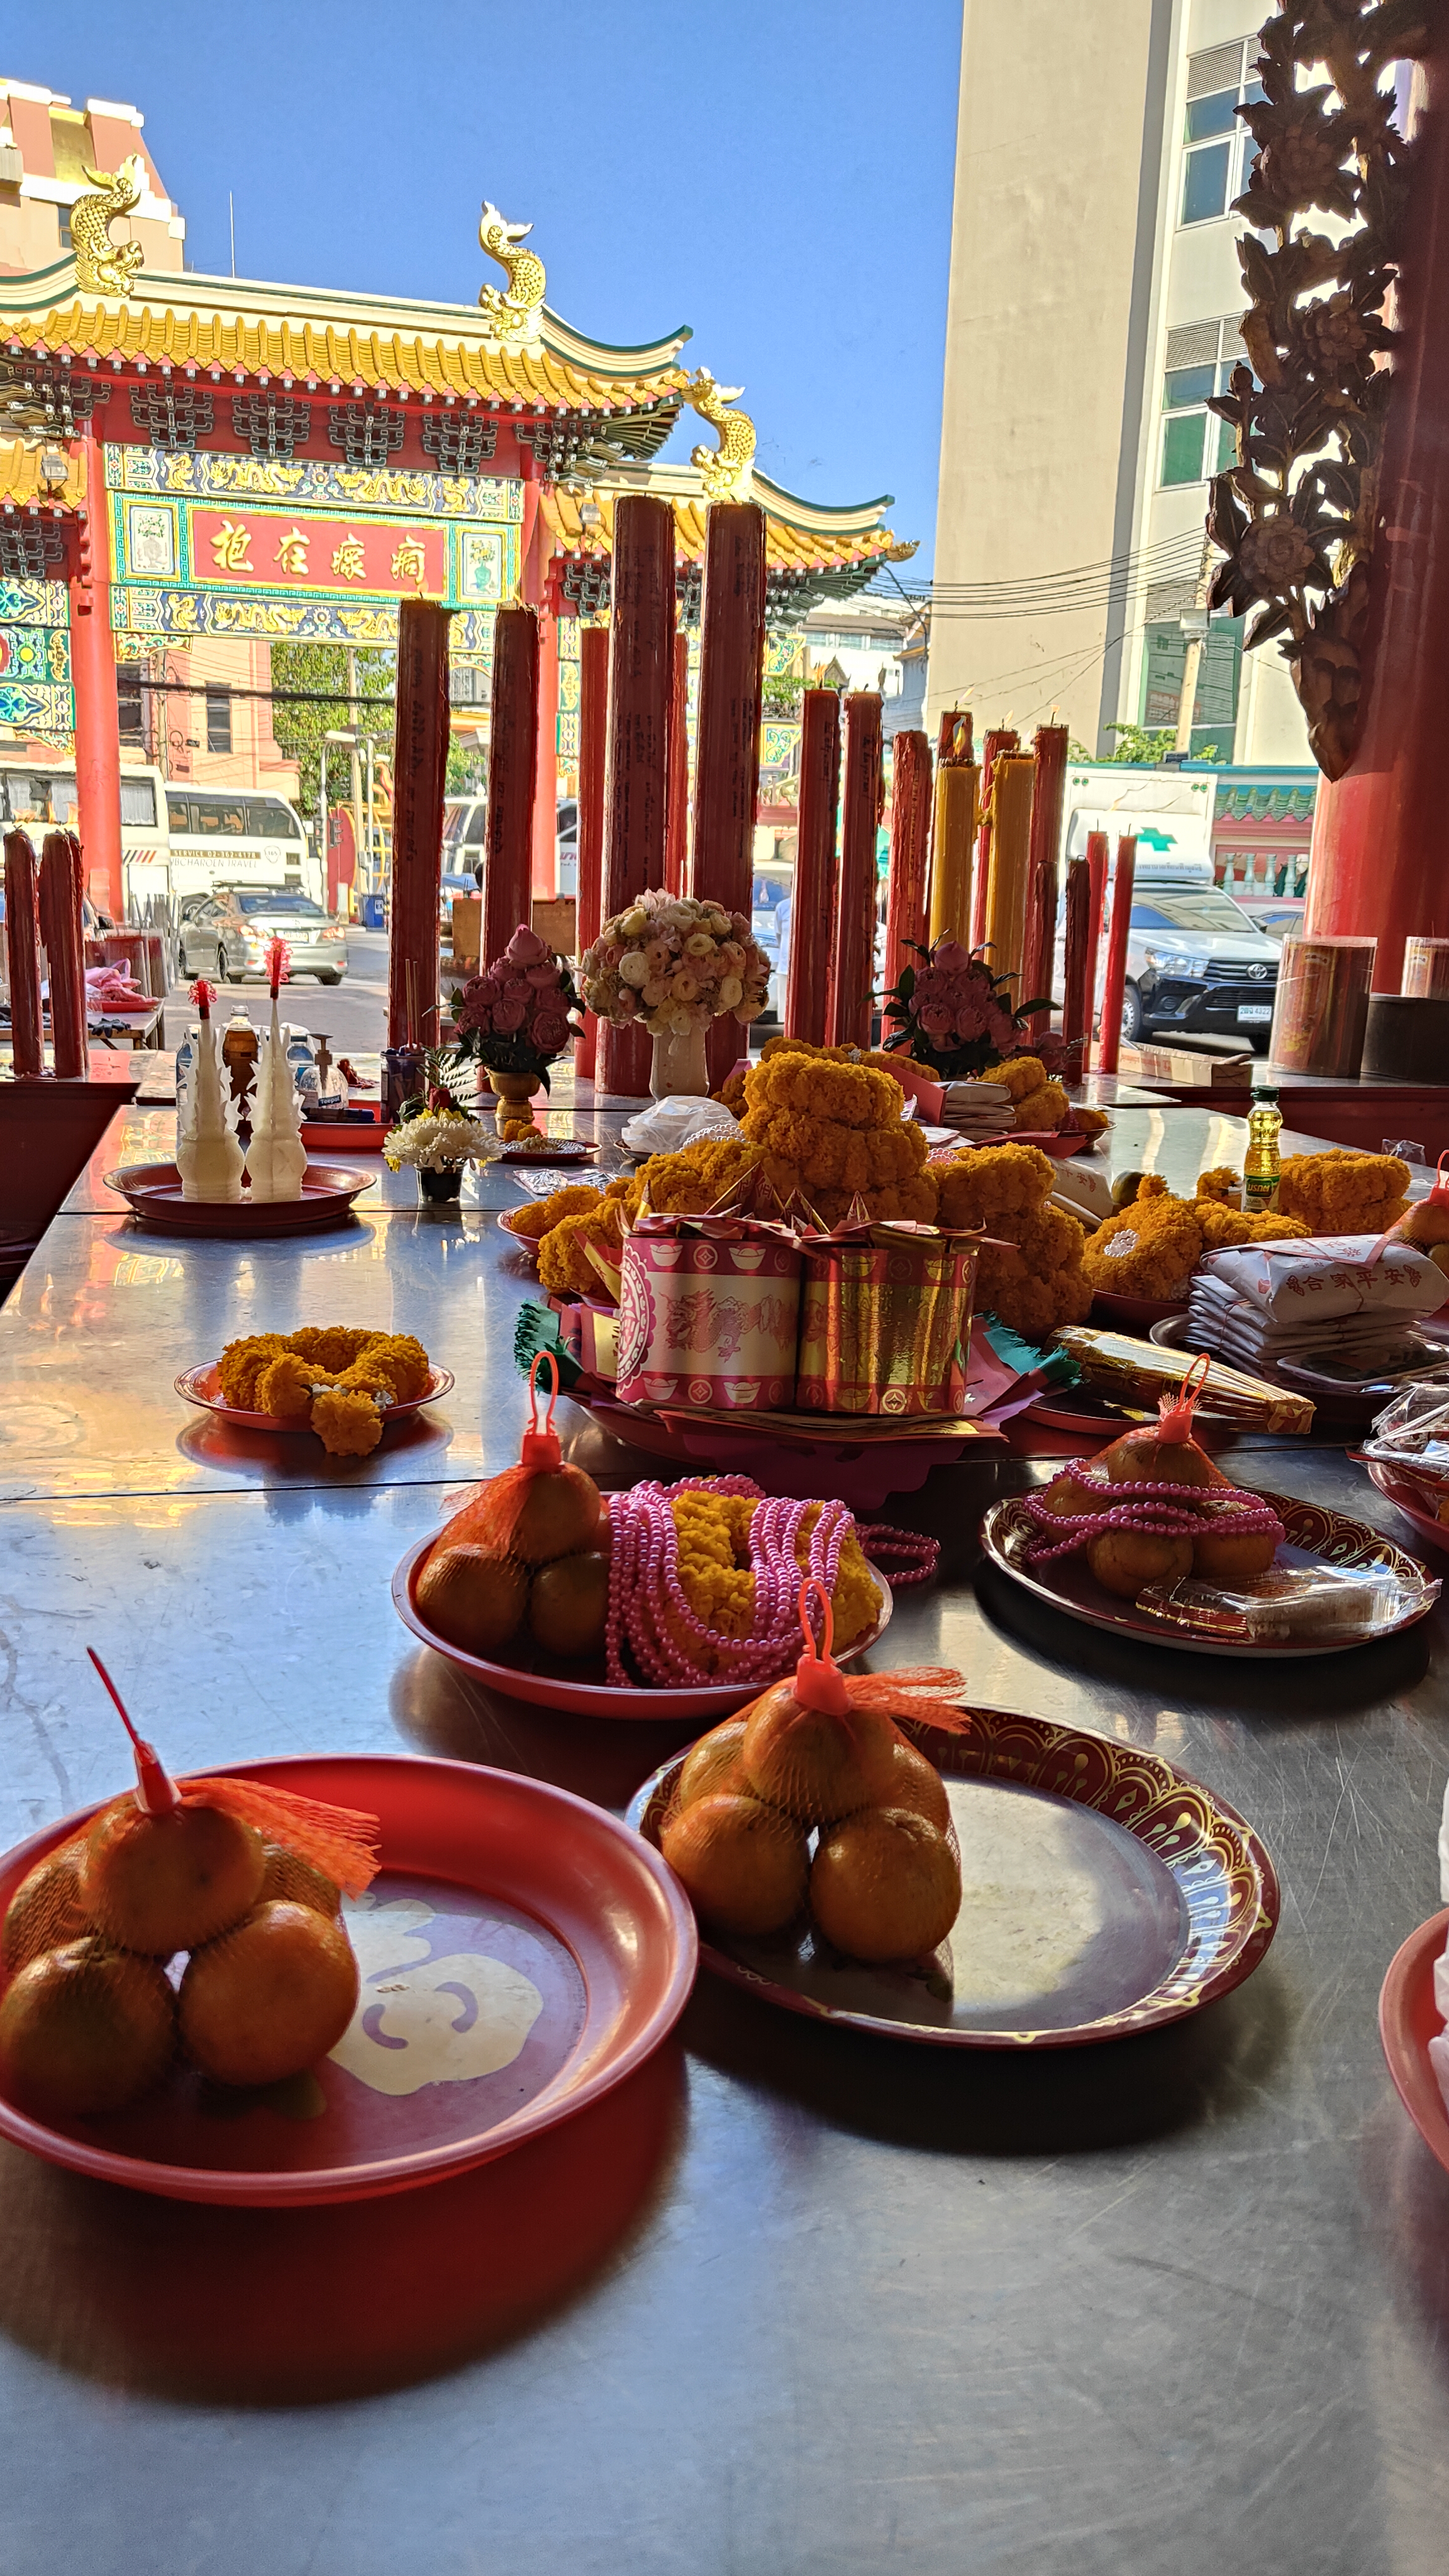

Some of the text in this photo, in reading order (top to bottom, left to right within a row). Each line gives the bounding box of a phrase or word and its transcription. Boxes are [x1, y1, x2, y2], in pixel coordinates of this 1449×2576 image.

[228, 860, 257, 868] TRAVEL
[1302, 1268, 1405, 1292] 合家平安
